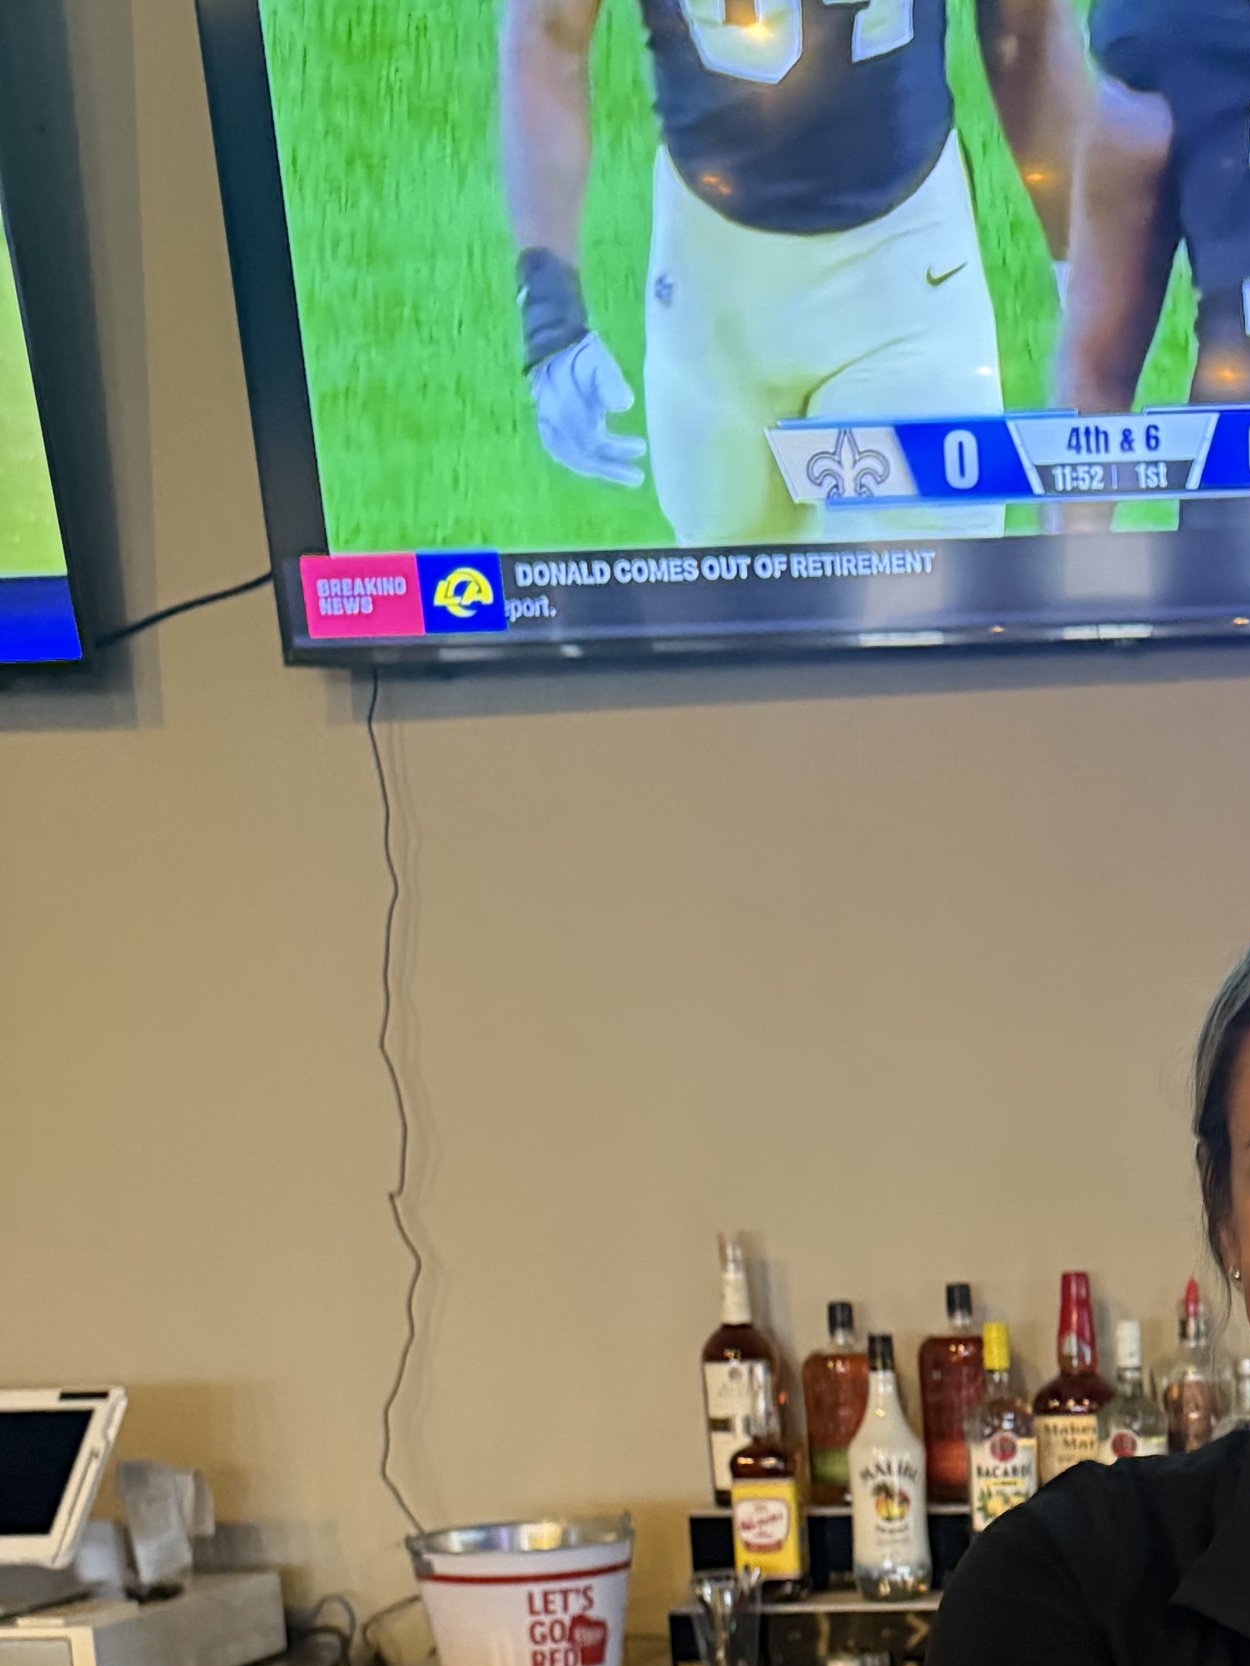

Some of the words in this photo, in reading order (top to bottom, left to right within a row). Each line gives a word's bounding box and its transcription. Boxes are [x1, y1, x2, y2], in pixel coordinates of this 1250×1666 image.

[1066, 424, 1109, 455] 4th
[1119, 427, 1136, 453] &
[1144, 423, 1161, 452] 6
[944, 429, 979, 490] 0
[1051, 465, 1105, 491] 11:52
[1134, 462, 1168, 489] 1st
[514, 561, 611, 587] DONALD
[613, 556, 700, 584] COMES
[700, 556, 751, 581] OUT
[753, 553, 788, 580] OF
[790, 550, 937, 580] RETIREMENT
[316, 576, 407, 599] BREAKING
[318, 596, 374, 616] NEWS
[527, 1585, 594, 1616] LET'S
[529, 1619, 567, 1645] GO
